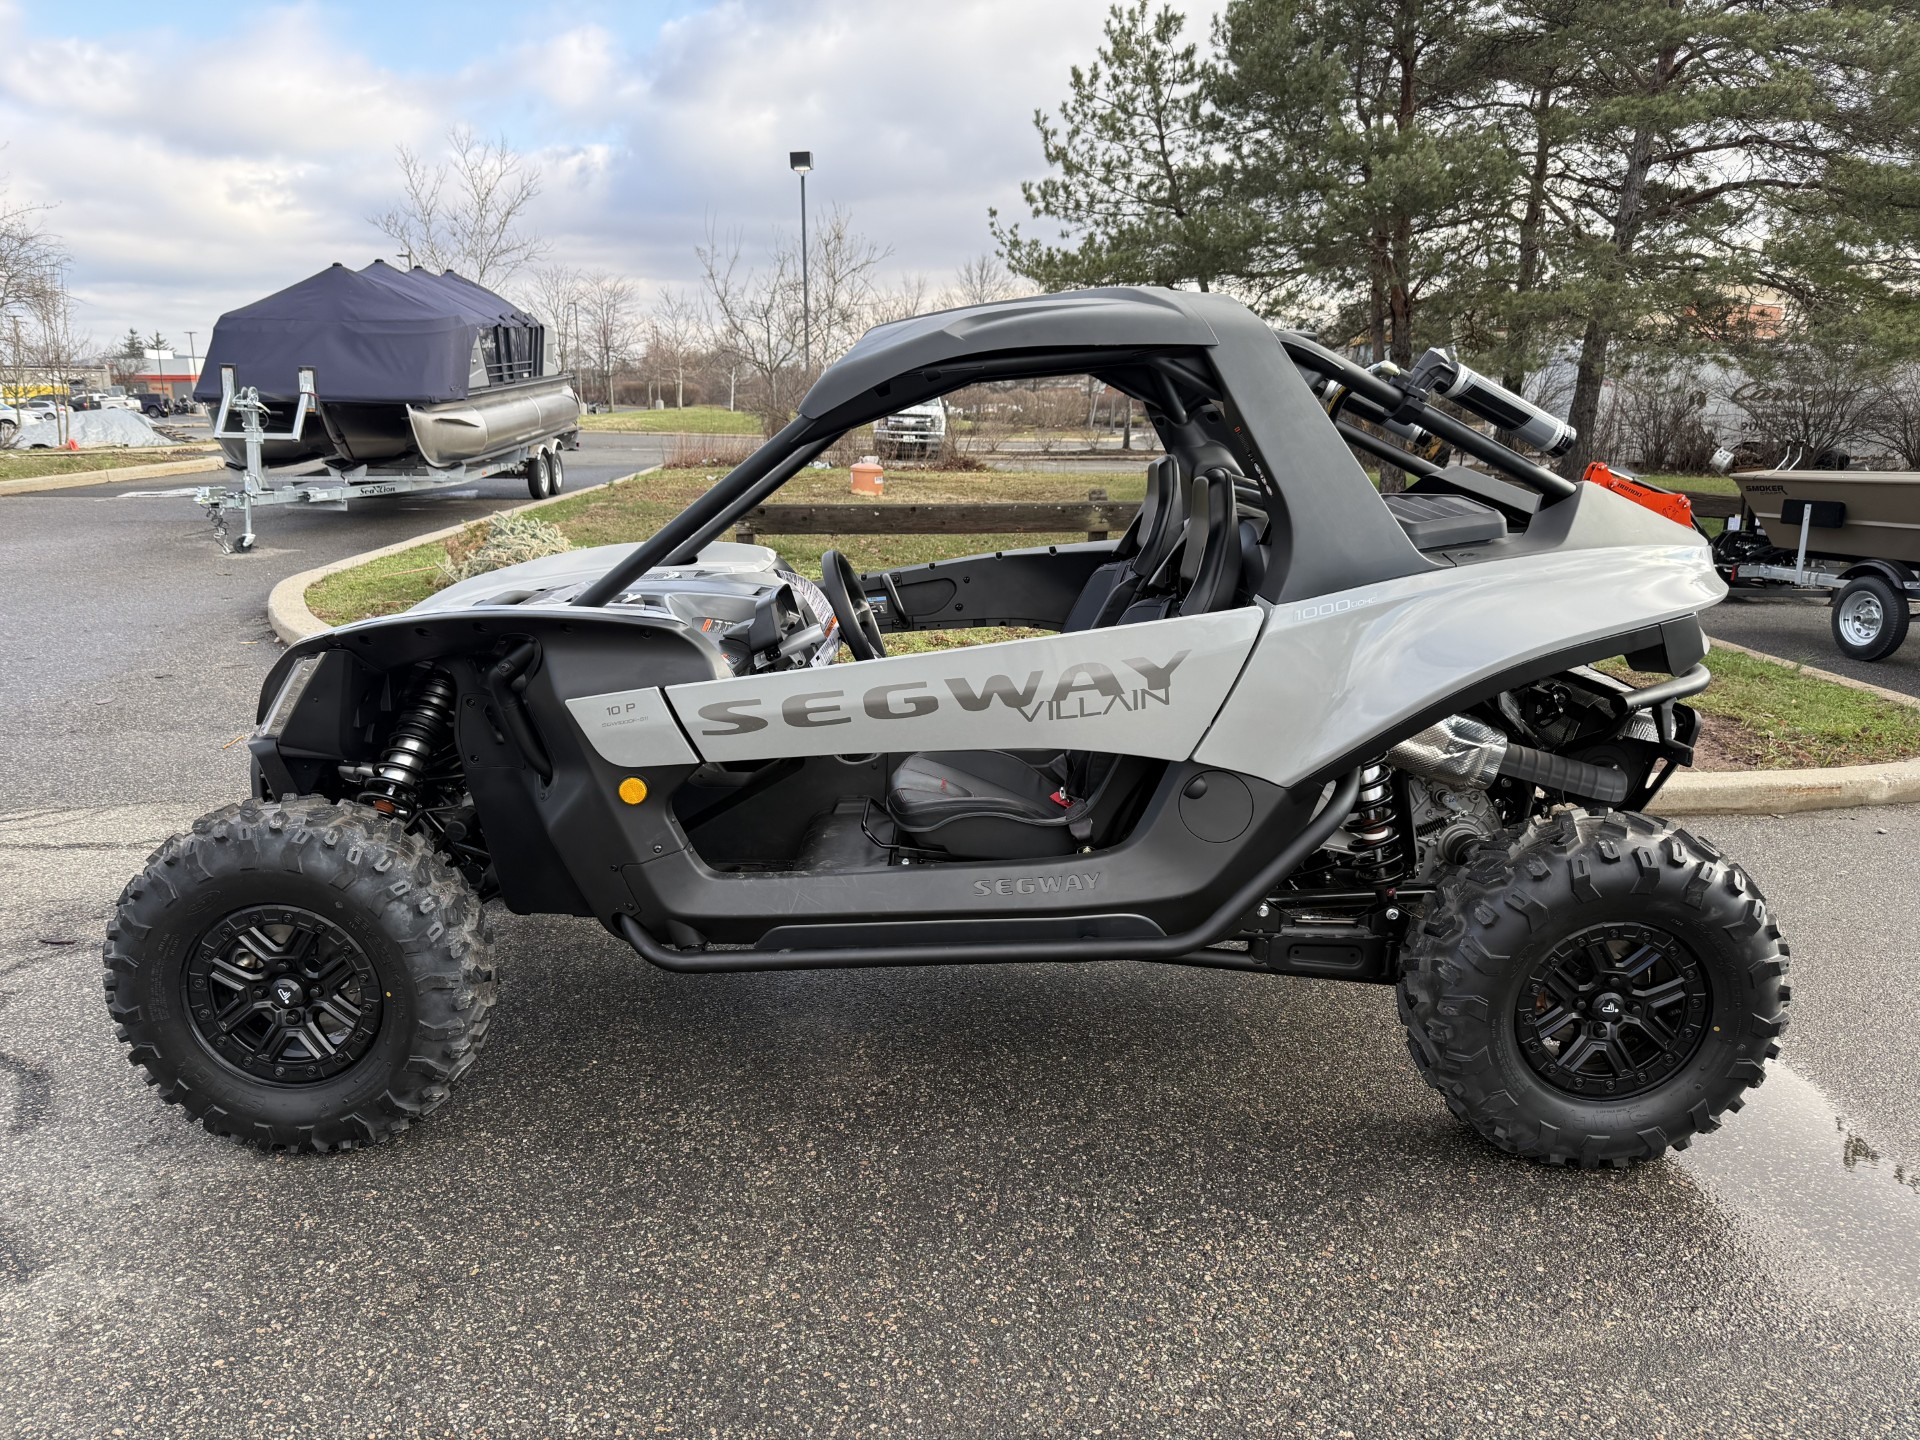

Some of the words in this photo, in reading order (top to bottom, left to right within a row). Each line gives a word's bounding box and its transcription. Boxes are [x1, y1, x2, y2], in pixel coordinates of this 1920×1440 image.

[1745, 485, 1788, 495] SMOKER
[697, 649, 1192, 736] SEGWAY
[1016, 687, 1170, 723] VILLAIN
[606, 705, 621, 716] 10
[625, 702, 636, 713] P
[973, 872, 1101, 897] SEGWAY
